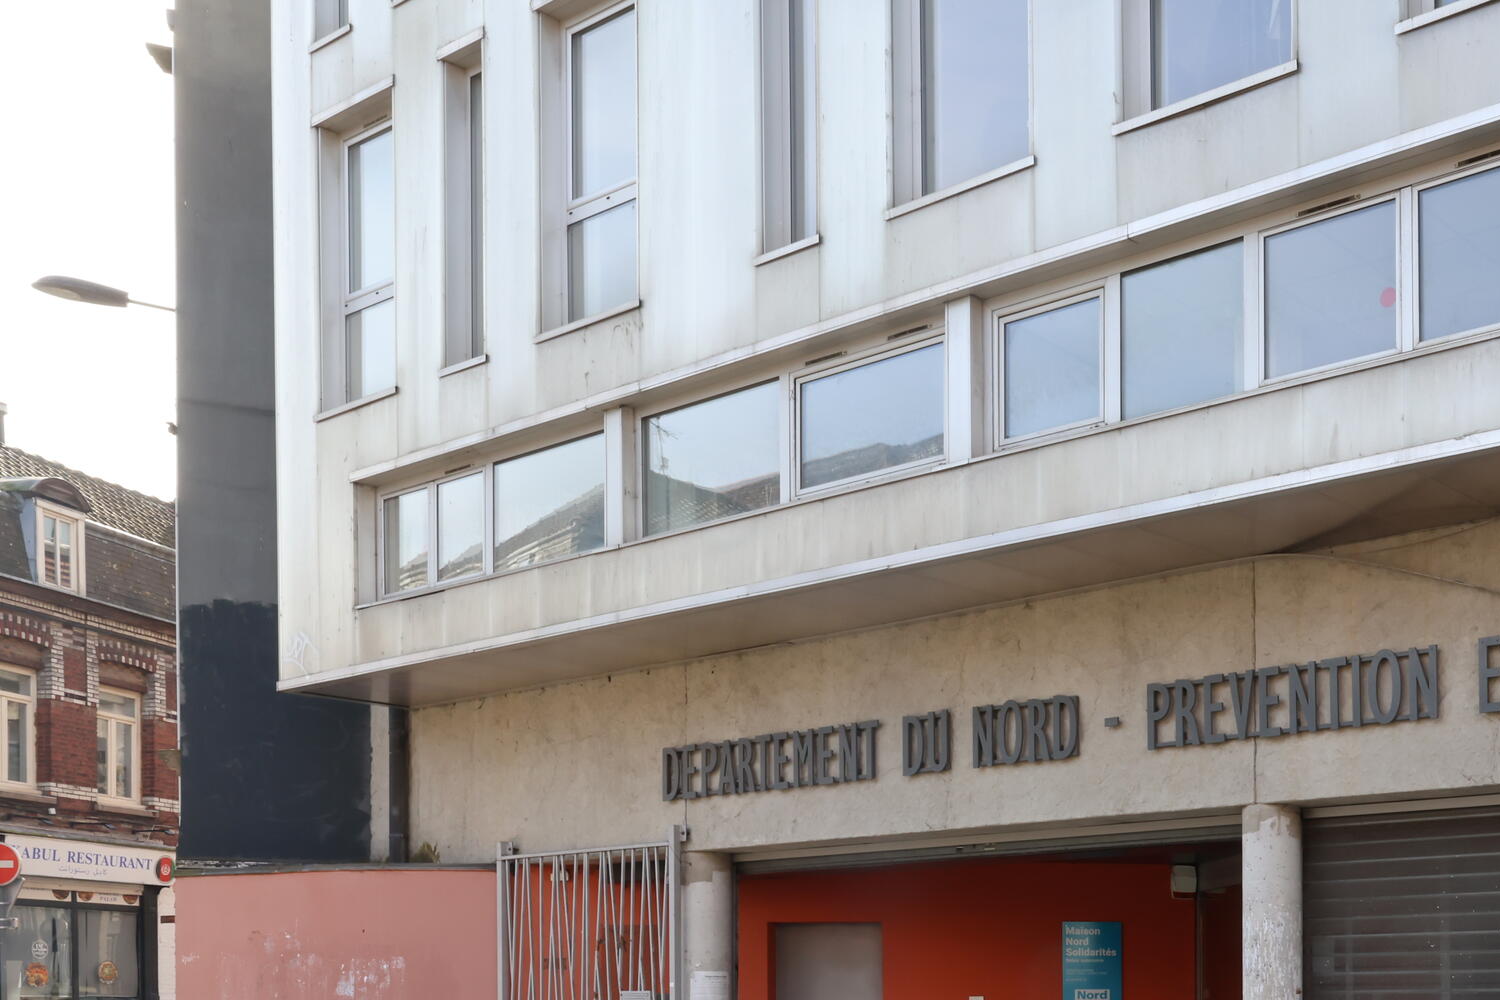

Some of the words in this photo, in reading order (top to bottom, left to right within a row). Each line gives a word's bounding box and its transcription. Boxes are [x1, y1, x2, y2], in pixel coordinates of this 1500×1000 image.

[662, 719, 881, 800] DEPARTEMENT
[903, 709, 951, 776] DU
[973, 695, 1080, 768] NORD
[1148, 645, 1438, 750] PREVENTION
[11, 844, 60, 862] ABUL
[67, 850, 153, 870] RESTAURANT
[1066, 926, 1100, 936] Maison
[1066, 937, 1089, 946] Nord
[1066, 947, 1117, 957] Solidarités
[1077, 990, 1108, 1000] Nord
